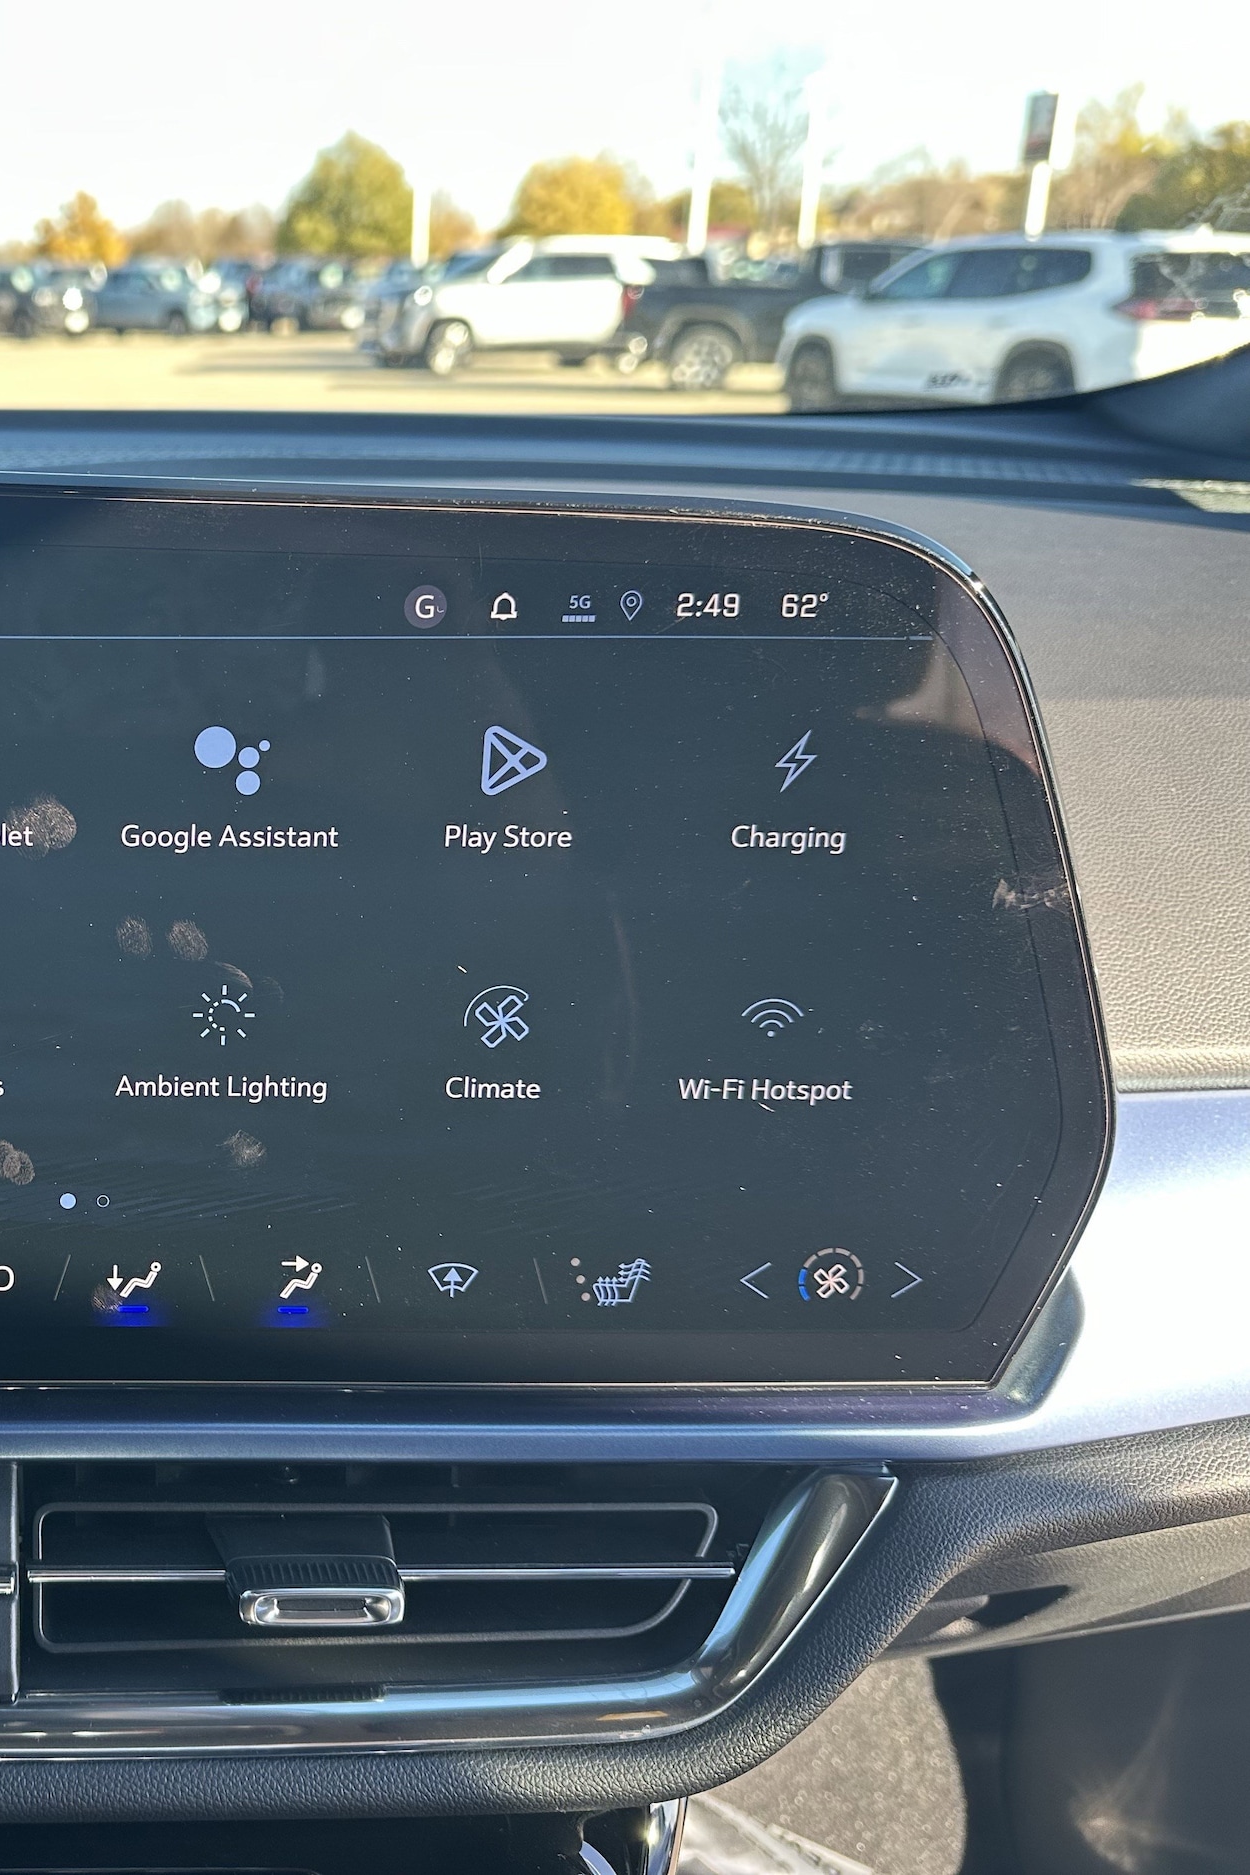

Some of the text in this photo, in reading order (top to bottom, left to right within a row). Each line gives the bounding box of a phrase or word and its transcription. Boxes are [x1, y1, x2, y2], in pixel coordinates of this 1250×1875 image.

[569, 595, 591, 609] 5G
[676, 592, 740, 618] 2:49
[121, 823, 339, 854] Google Assistant
[444, 823, 573, 854] Play Store
[731, 824, 846, 855] Charging
[115, 1074, 327, 1104] Ambient Lighting
[445, 1075, 541, 1099] Climate
[678, 1078, 853, 1106] Wi-Fi Hotspot
